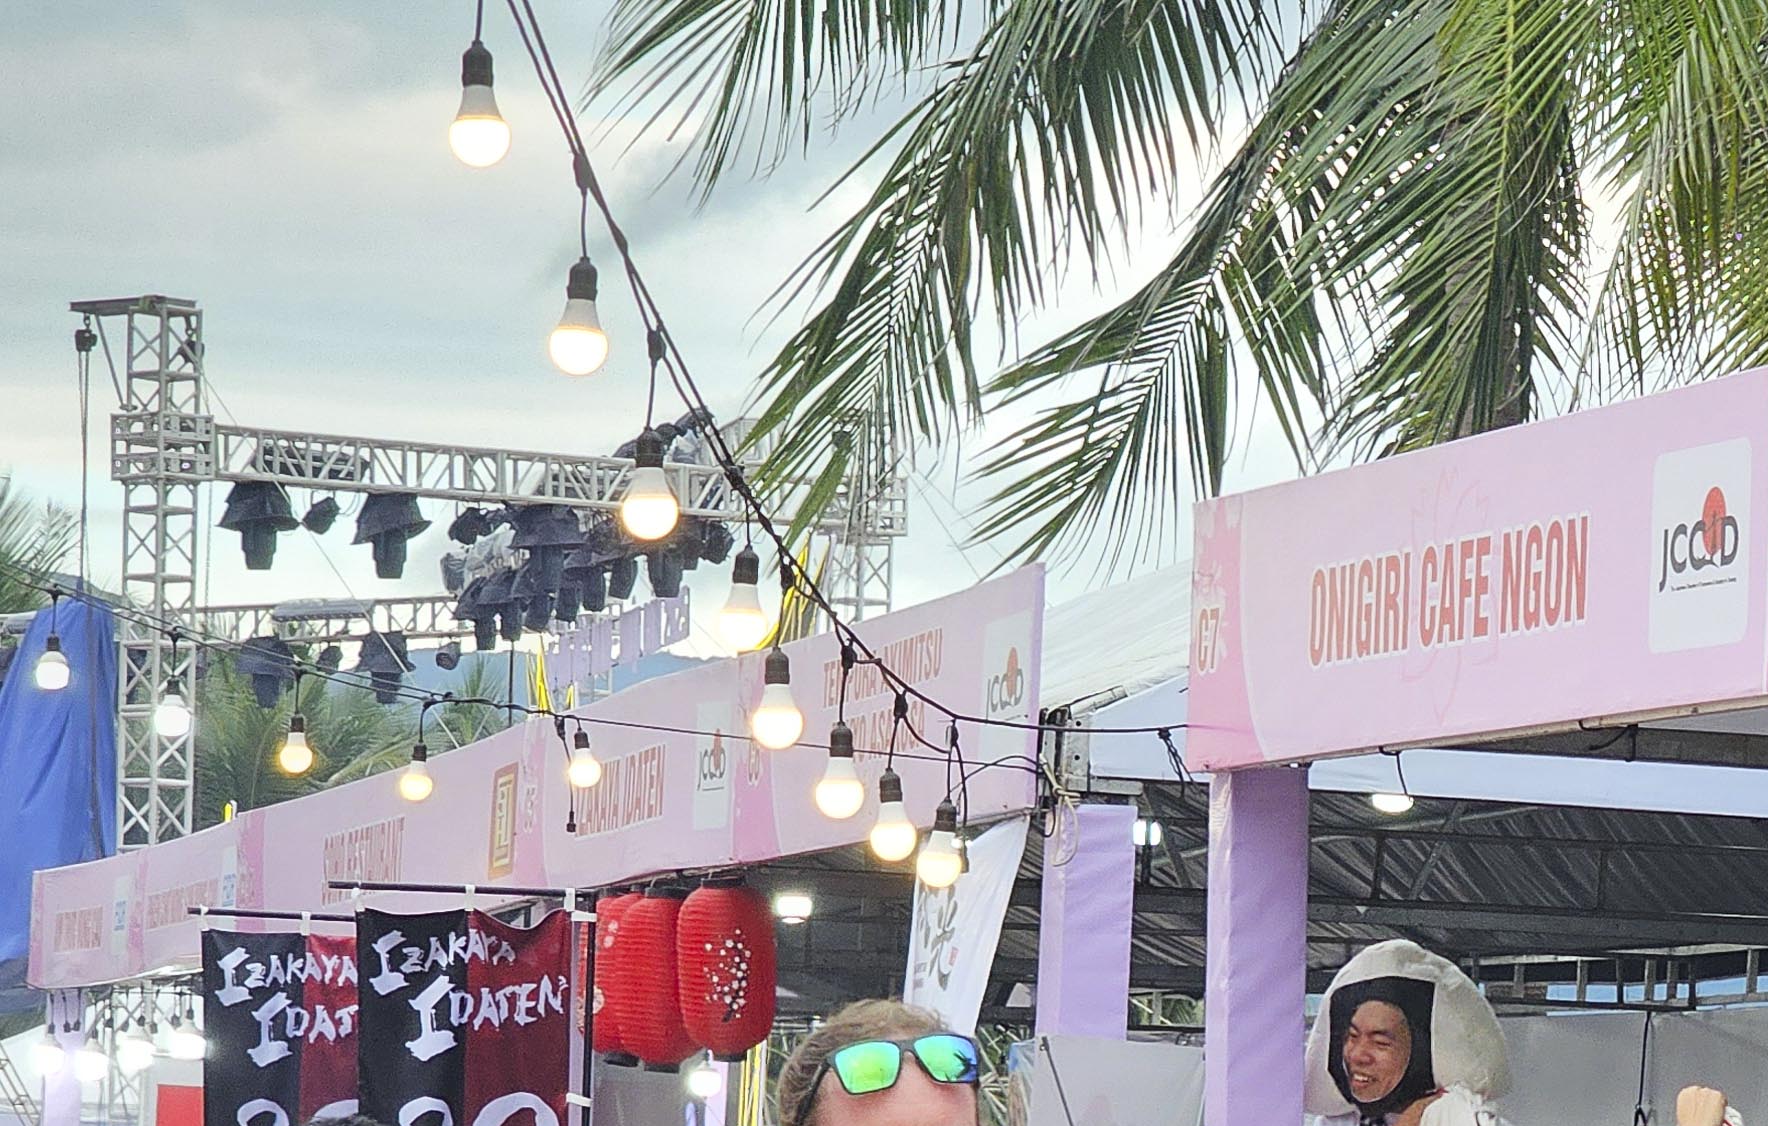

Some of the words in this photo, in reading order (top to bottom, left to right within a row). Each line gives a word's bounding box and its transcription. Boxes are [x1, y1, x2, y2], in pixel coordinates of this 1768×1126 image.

[1309, 554, 1410, 666] ONIGIRI
[1420, 535, 1490, 648] CAFE
[1501, 517, 1588, 634] NGON
[1198, 607, 1219, 671] C7
[623, 744, 666, 826] IDATEN
[214, 947, 358, 1007] IZAKAYA
[369, 930, 516, 996] IZAKAYA
[405, 974, 569, 1062] IDATEN
